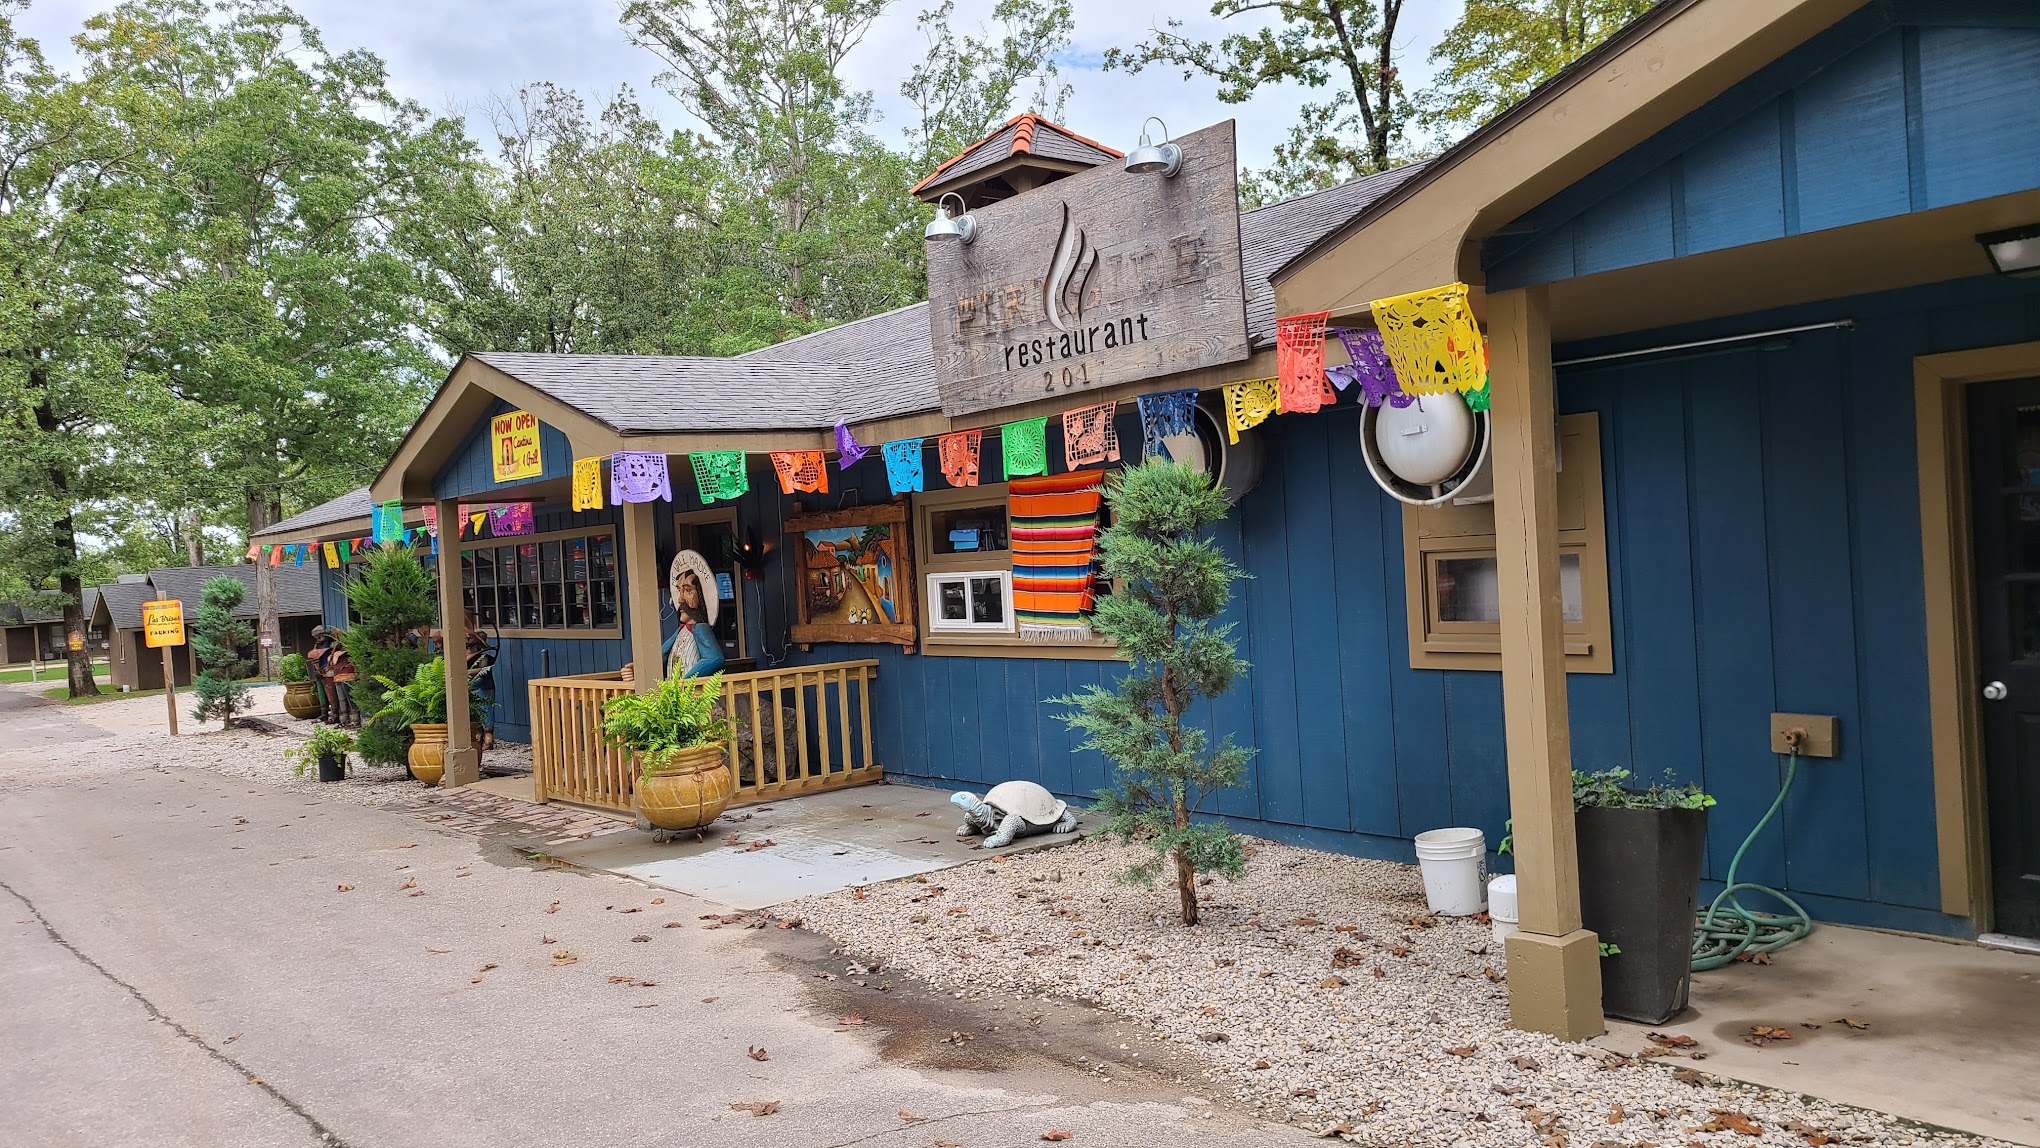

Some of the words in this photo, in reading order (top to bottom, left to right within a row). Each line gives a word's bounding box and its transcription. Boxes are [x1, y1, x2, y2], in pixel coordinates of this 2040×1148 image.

[1004, 314, 1149, 371] restaurant
[495, 417, 512, 436] NOW
[516, 413, 536, 431] OPEN
[689, 553, 711, 584] MADRE
[147, 613, 159, 626] Las
[149, 627, 179, 636] PARKING
